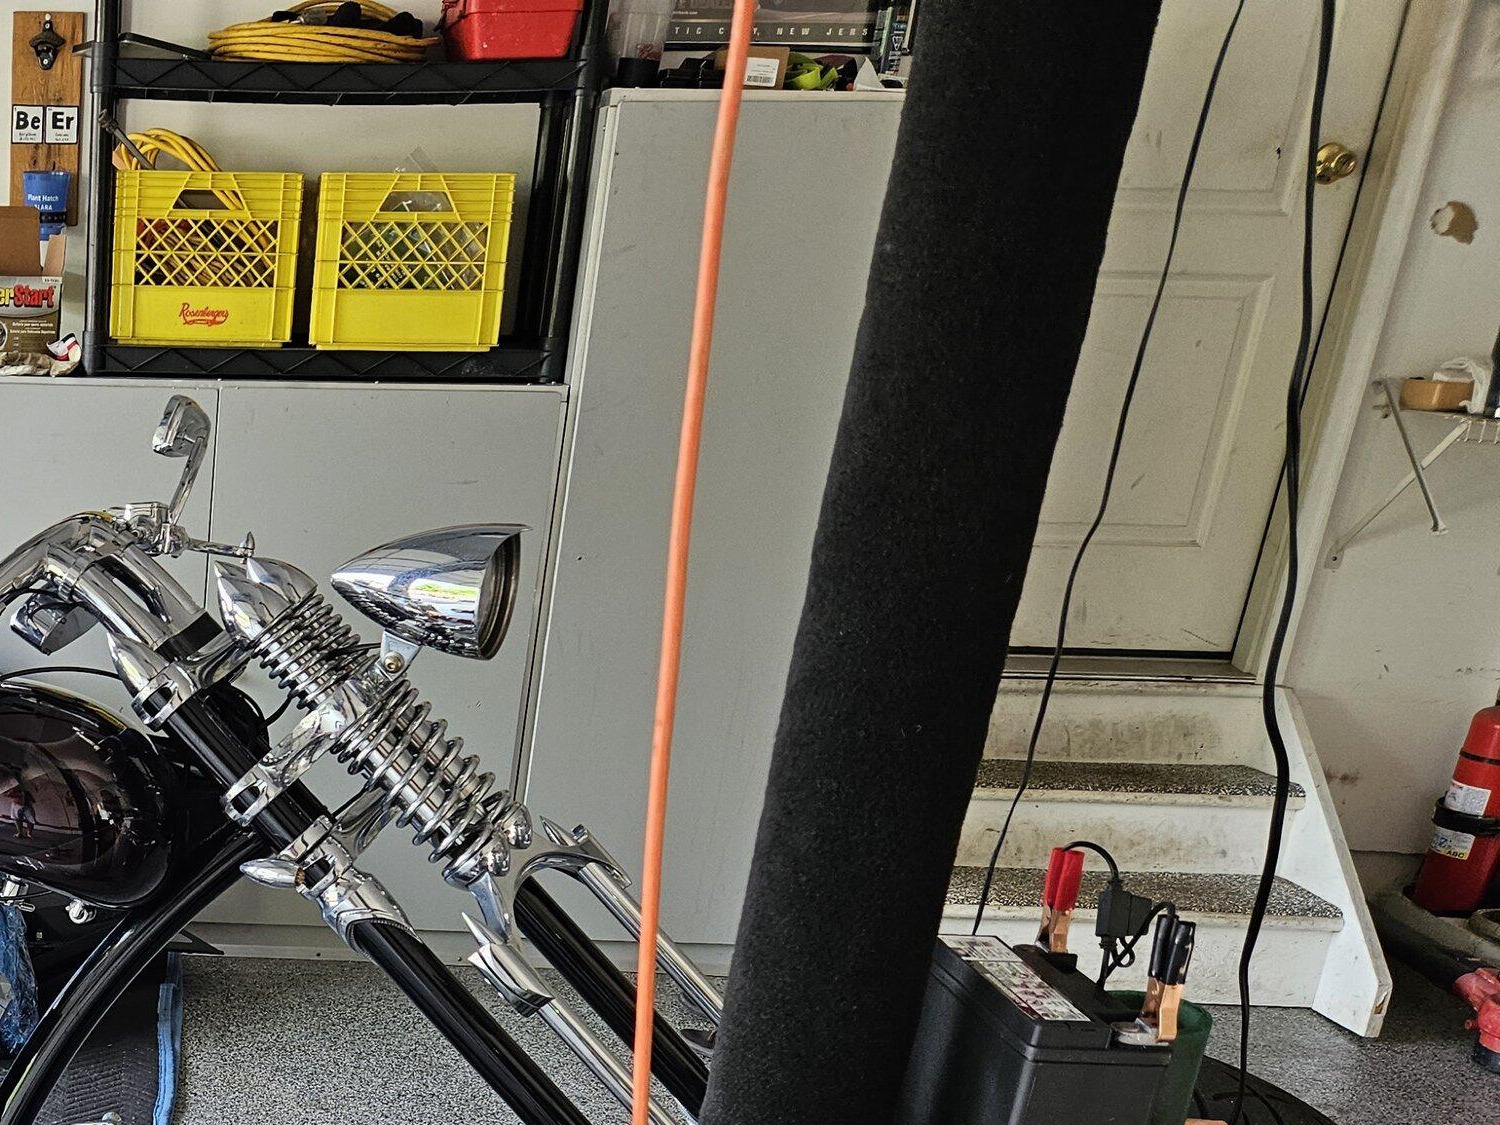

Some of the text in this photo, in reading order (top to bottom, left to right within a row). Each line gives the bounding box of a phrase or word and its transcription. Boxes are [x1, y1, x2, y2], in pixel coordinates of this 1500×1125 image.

[776, 26, 811, 36] NEW
[825, 26, 869, 37] JERS
[15, 110, 74, 130] Be Er
[1446, 850, 1465, 859] ABC
